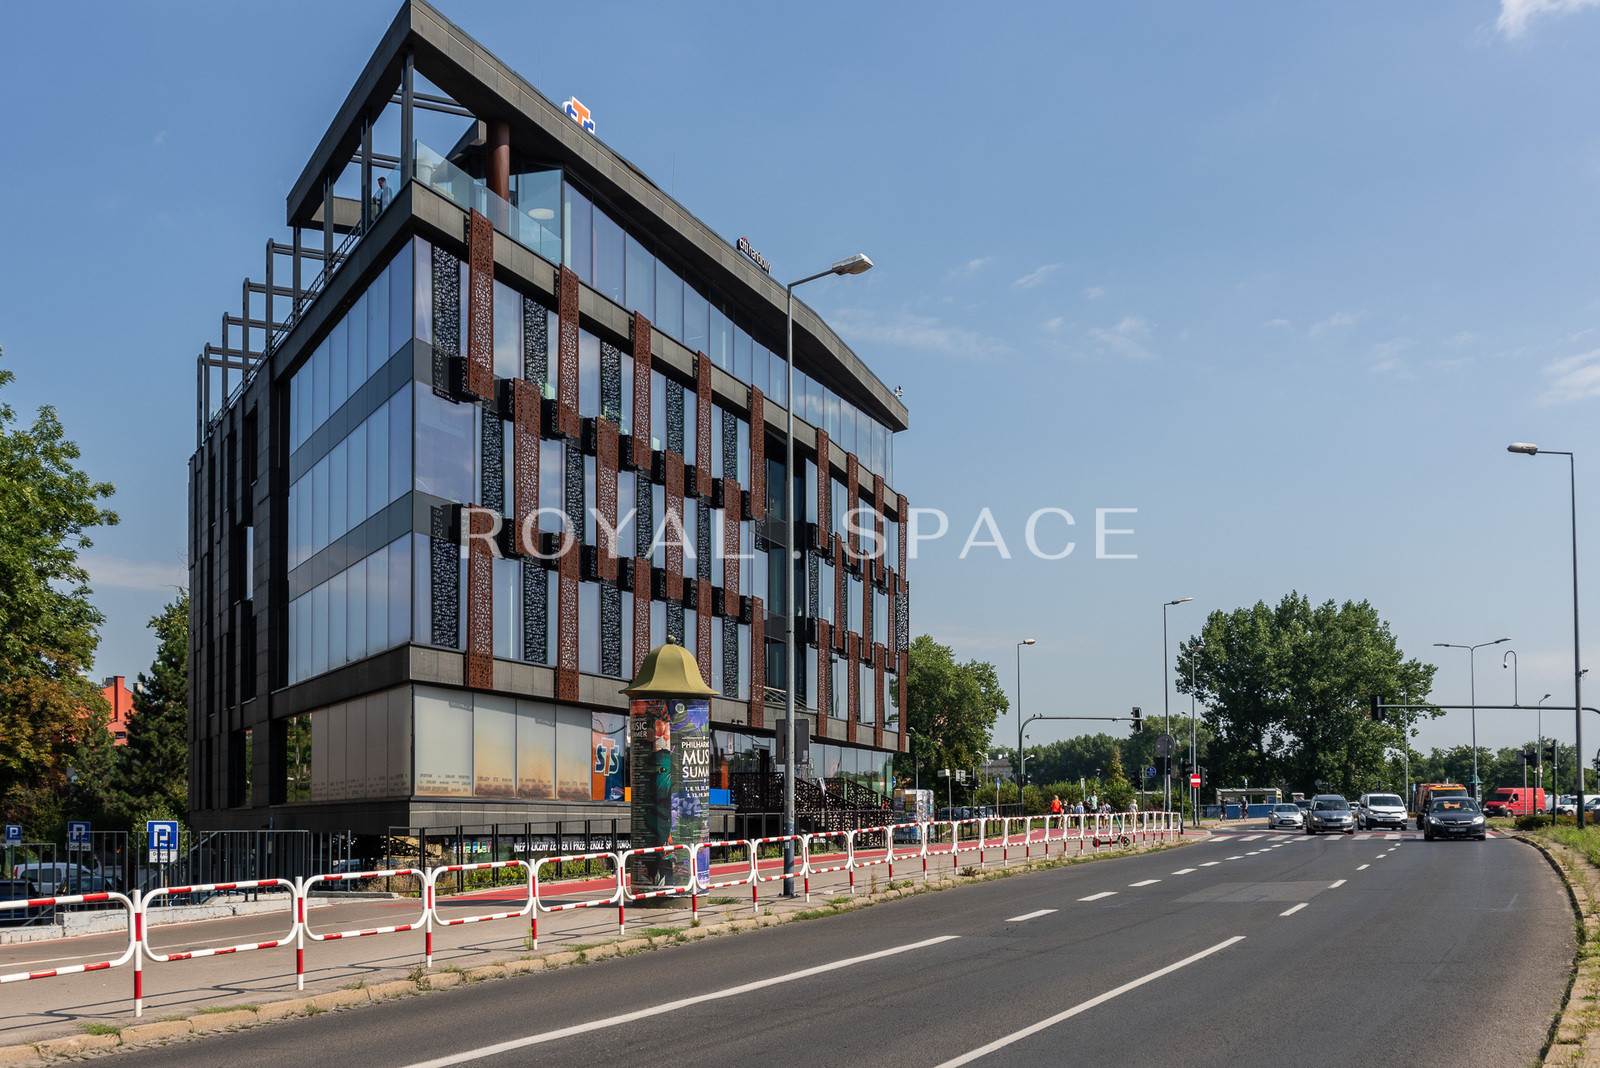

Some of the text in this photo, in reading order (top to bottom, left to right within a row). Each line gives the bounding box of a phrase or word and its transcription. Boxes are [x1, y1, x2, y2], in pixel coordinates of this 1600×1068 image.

[594, 737, 619, 777] STS
[10, 828, 18, 838] P
[73, 824, 86, 840] P
[154, 825, 172, 847] P
